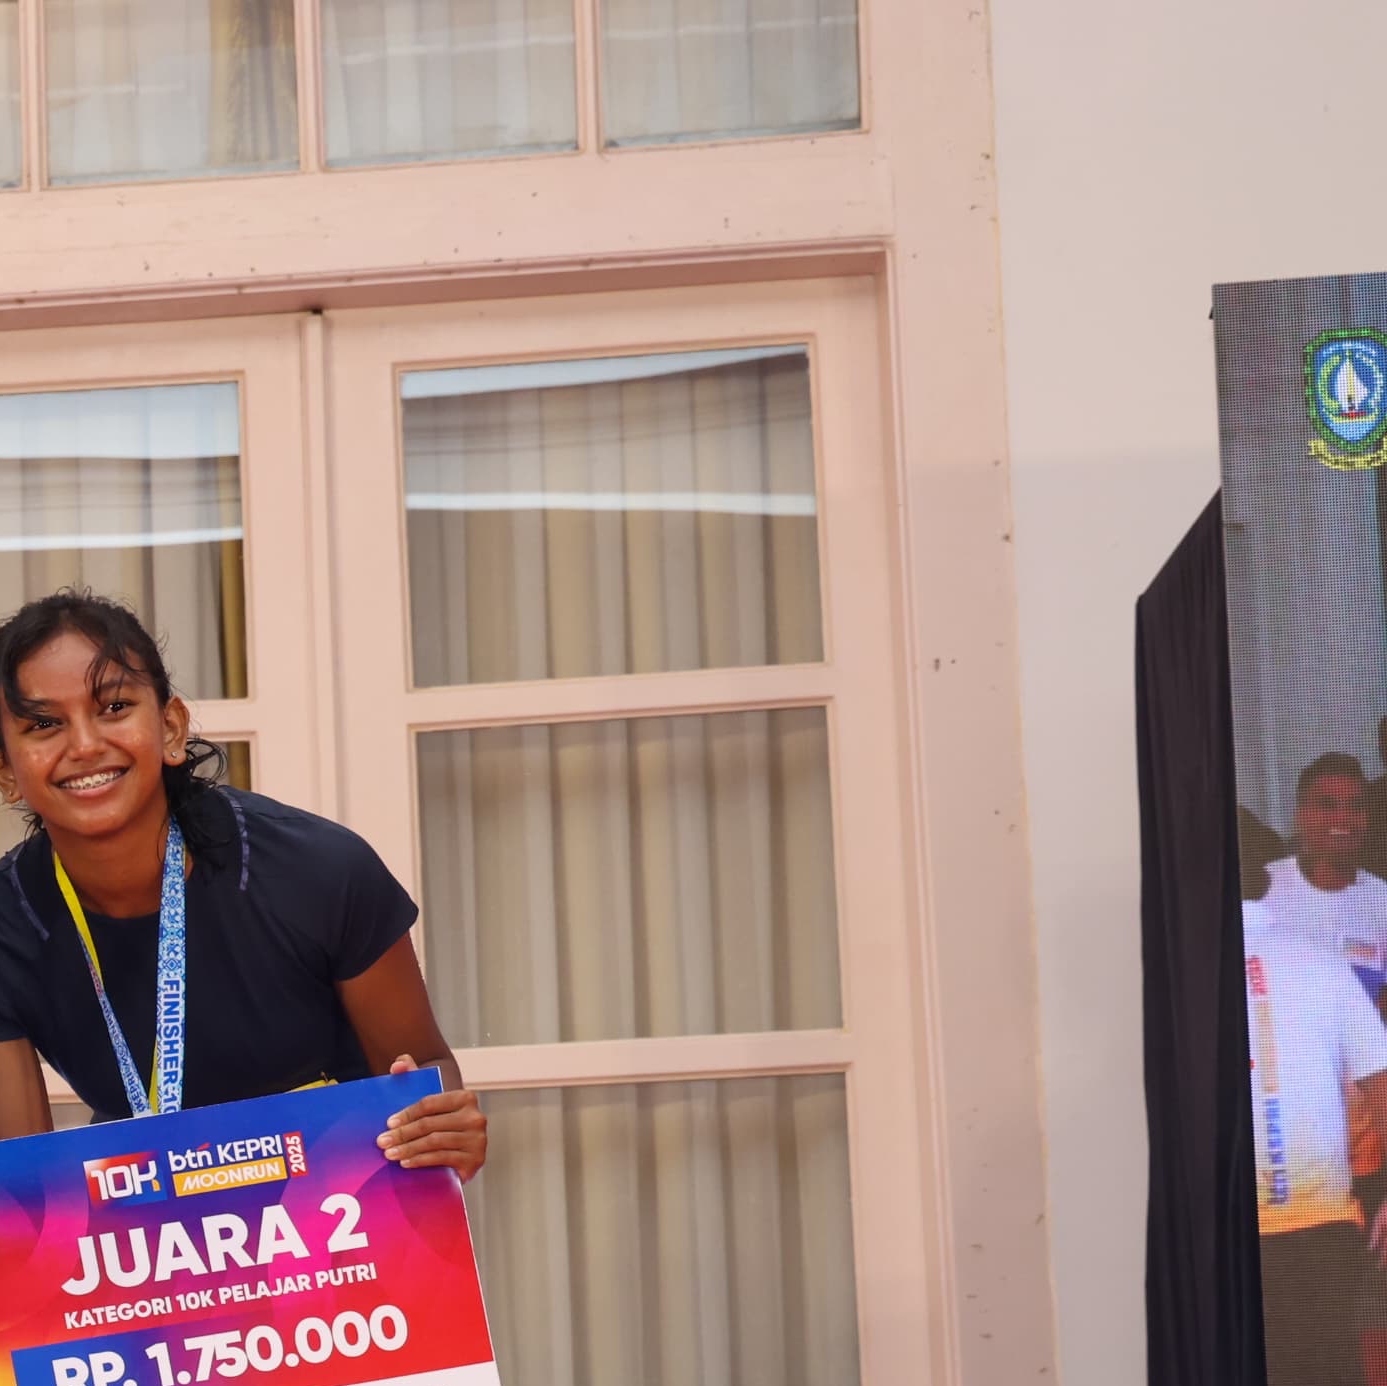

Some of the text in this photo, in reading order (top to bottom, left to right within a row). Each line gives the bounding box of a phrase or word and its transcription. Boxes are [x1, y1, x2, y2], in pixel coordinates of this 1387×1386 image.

[168, 1134, 283, 1171] btn KEPRI
[287, 1136, 306, 1173] 2025
[91, 1160, 161, 1201] 10K
[182, 1162, 281, 1192] MOONRUN
[61, 1193, 369, 1295] JUARA 2
[65, 1263, 377, 1330] KATEGORI 10K PELAJAR PUTRI
